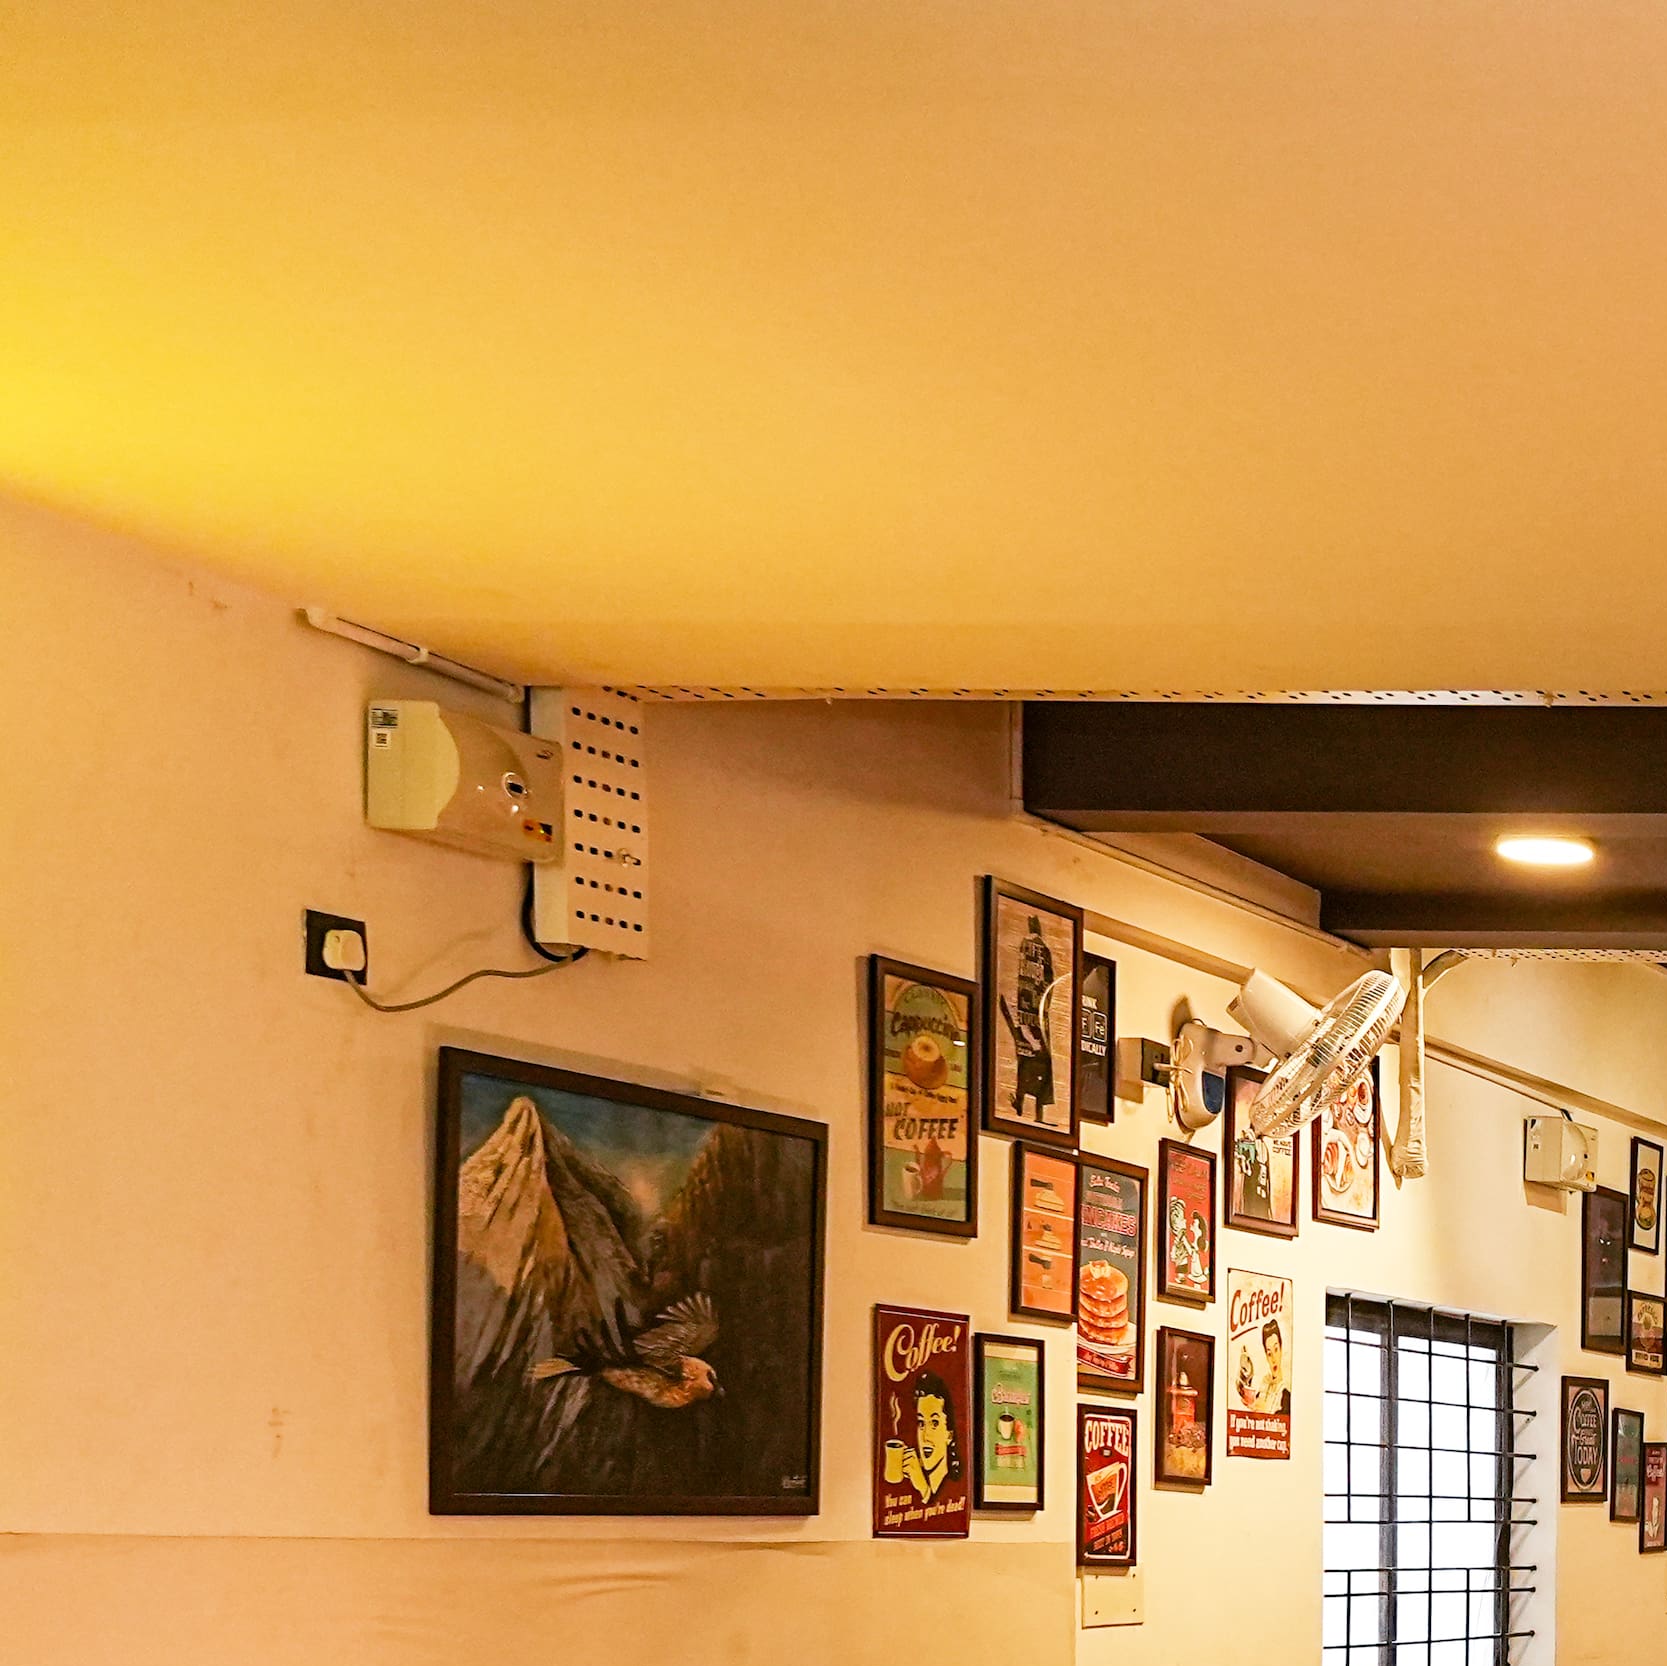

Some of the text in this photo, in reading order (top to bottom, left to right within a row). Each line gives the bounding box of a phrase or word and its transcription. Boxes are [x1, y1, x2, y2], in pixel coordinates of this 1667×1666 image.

[893, 1117, 959, 1141] COFFEE
[1230, 1281, 1285, 1333] Coffee!
[884, 1322, 962, 1382] Coffee!
[1084, 1420, 1129, 1458] COFFEE
[1571, 1434, 1598, 1465] TODAY
